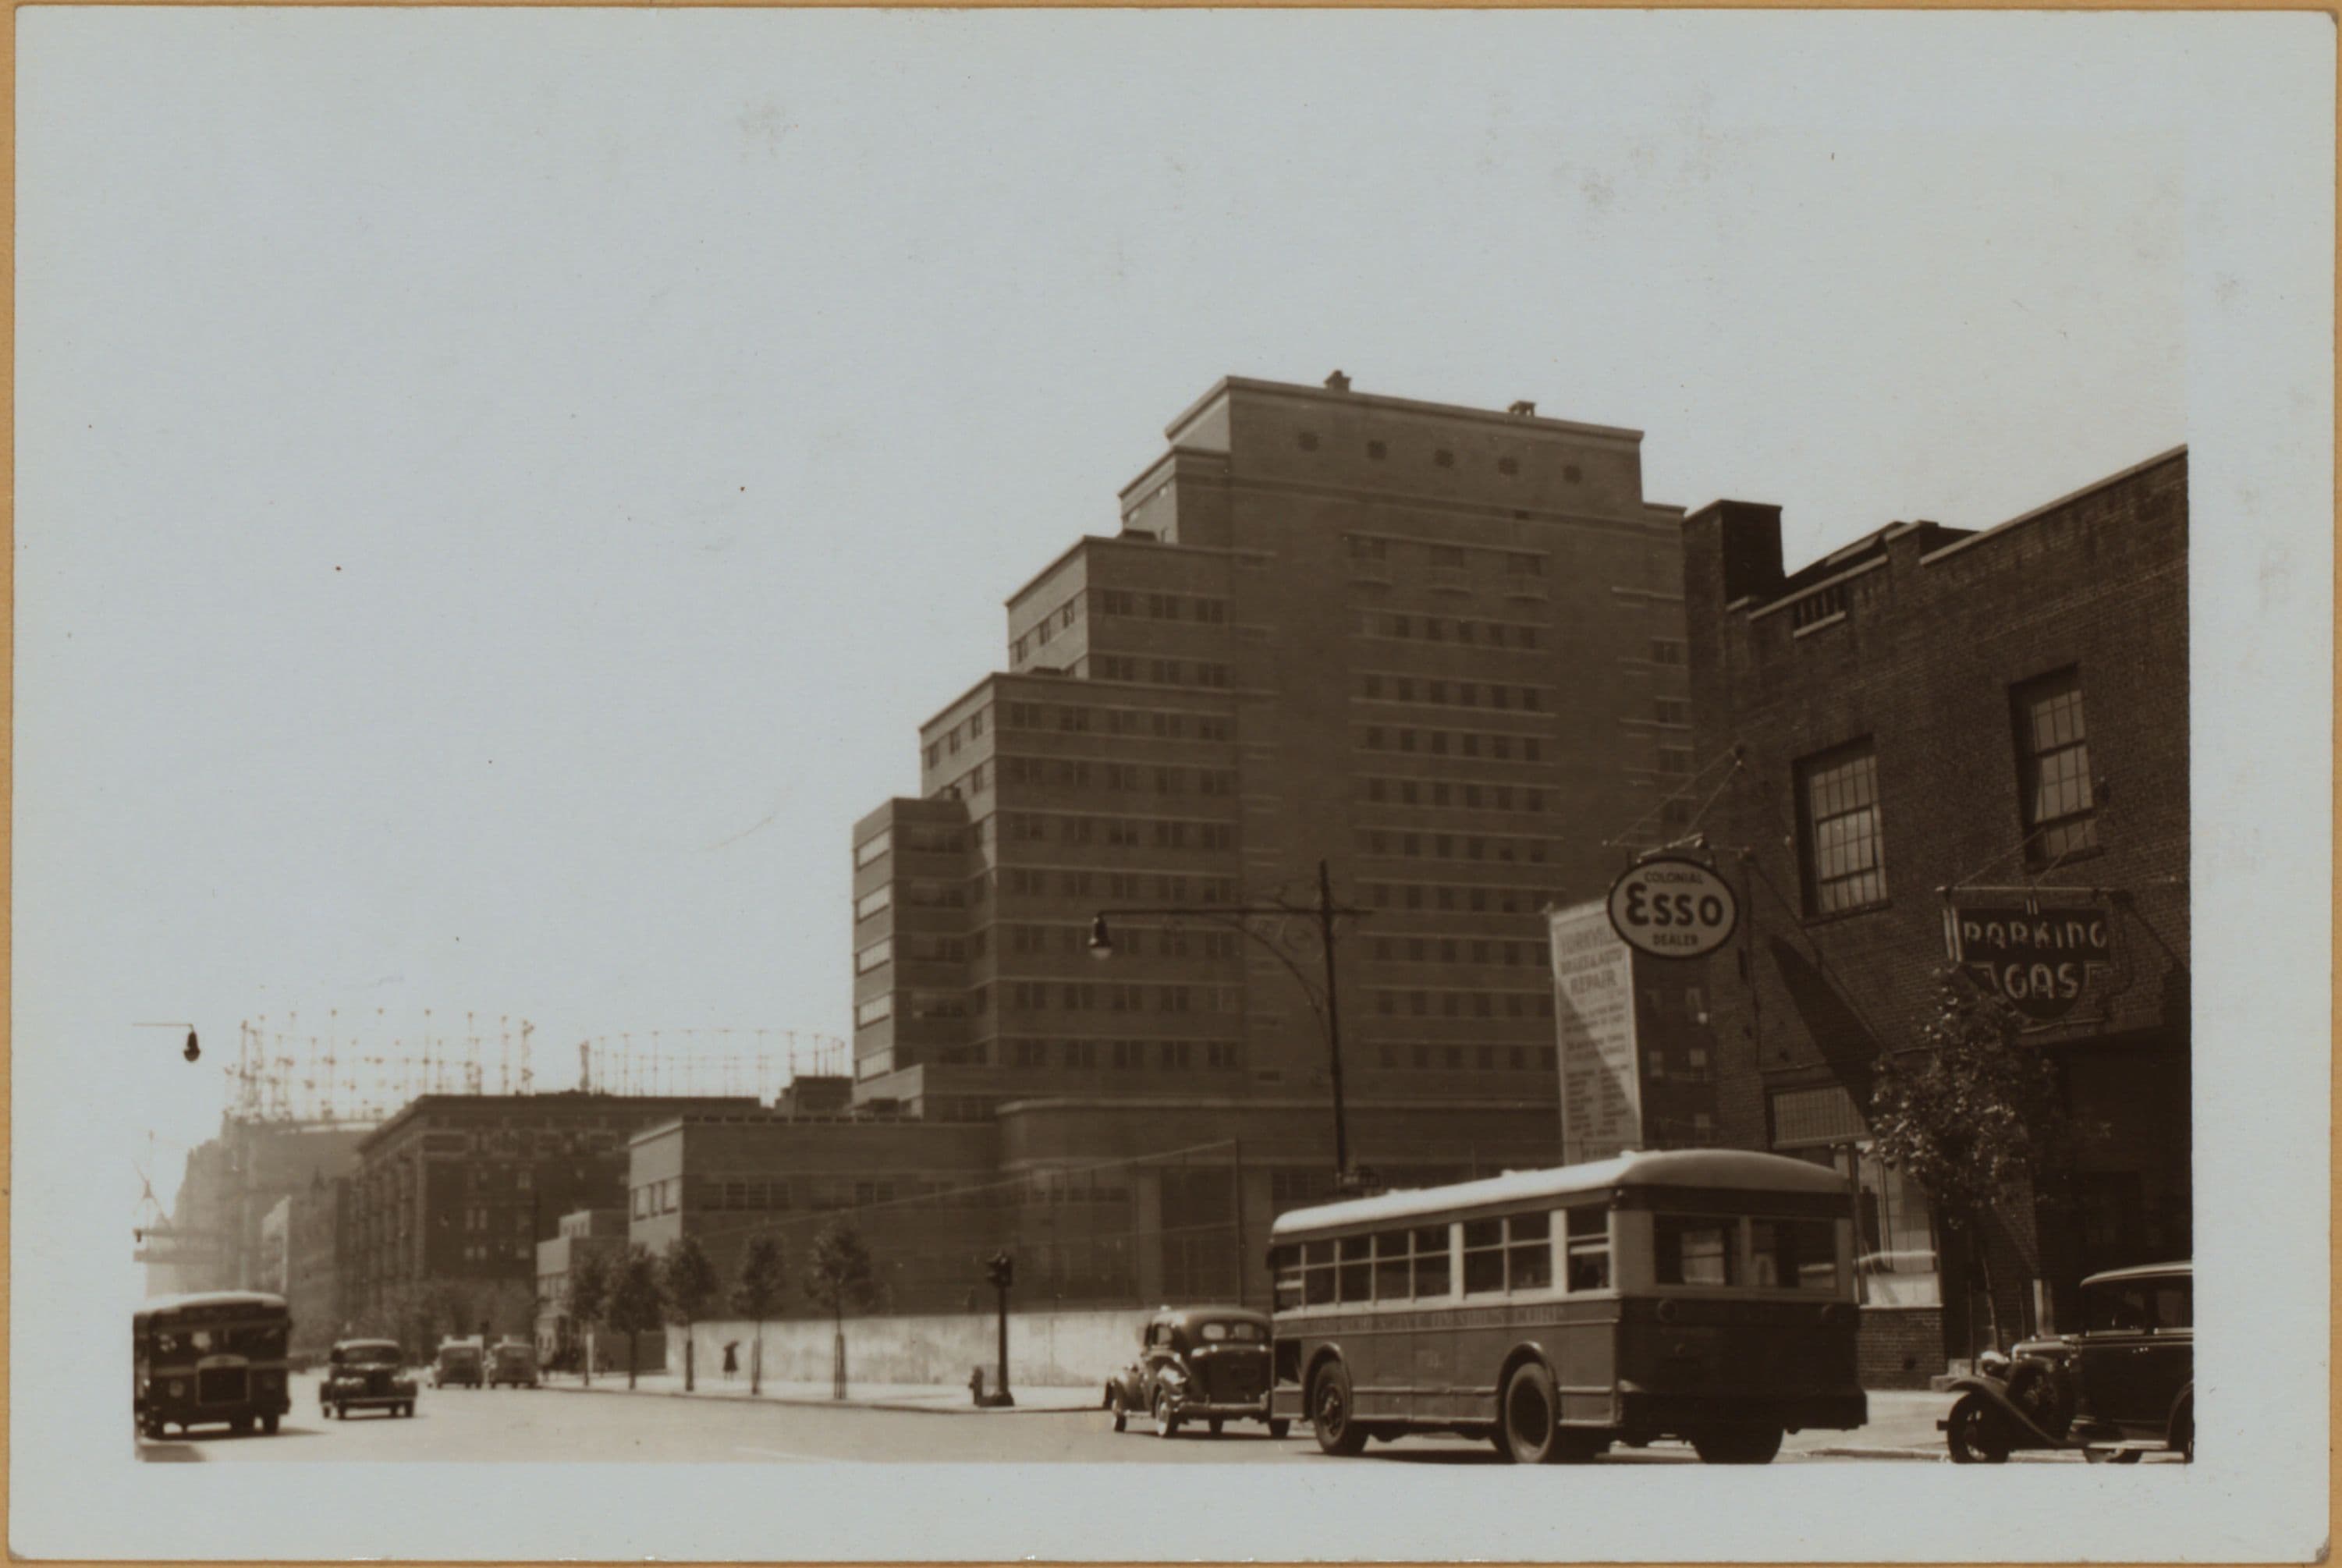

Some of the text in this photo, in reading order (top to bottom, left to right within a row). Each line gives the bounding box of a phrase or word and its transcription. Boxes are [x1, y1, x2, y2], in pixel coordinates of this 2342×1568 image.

[1644, 871, 1705, 885] COLONIAL
[1652, 933, 1700, 946] DEALER
[1963, 919, 2108, 949] PARKING
[2003, 961, 2080, 999] GAS
